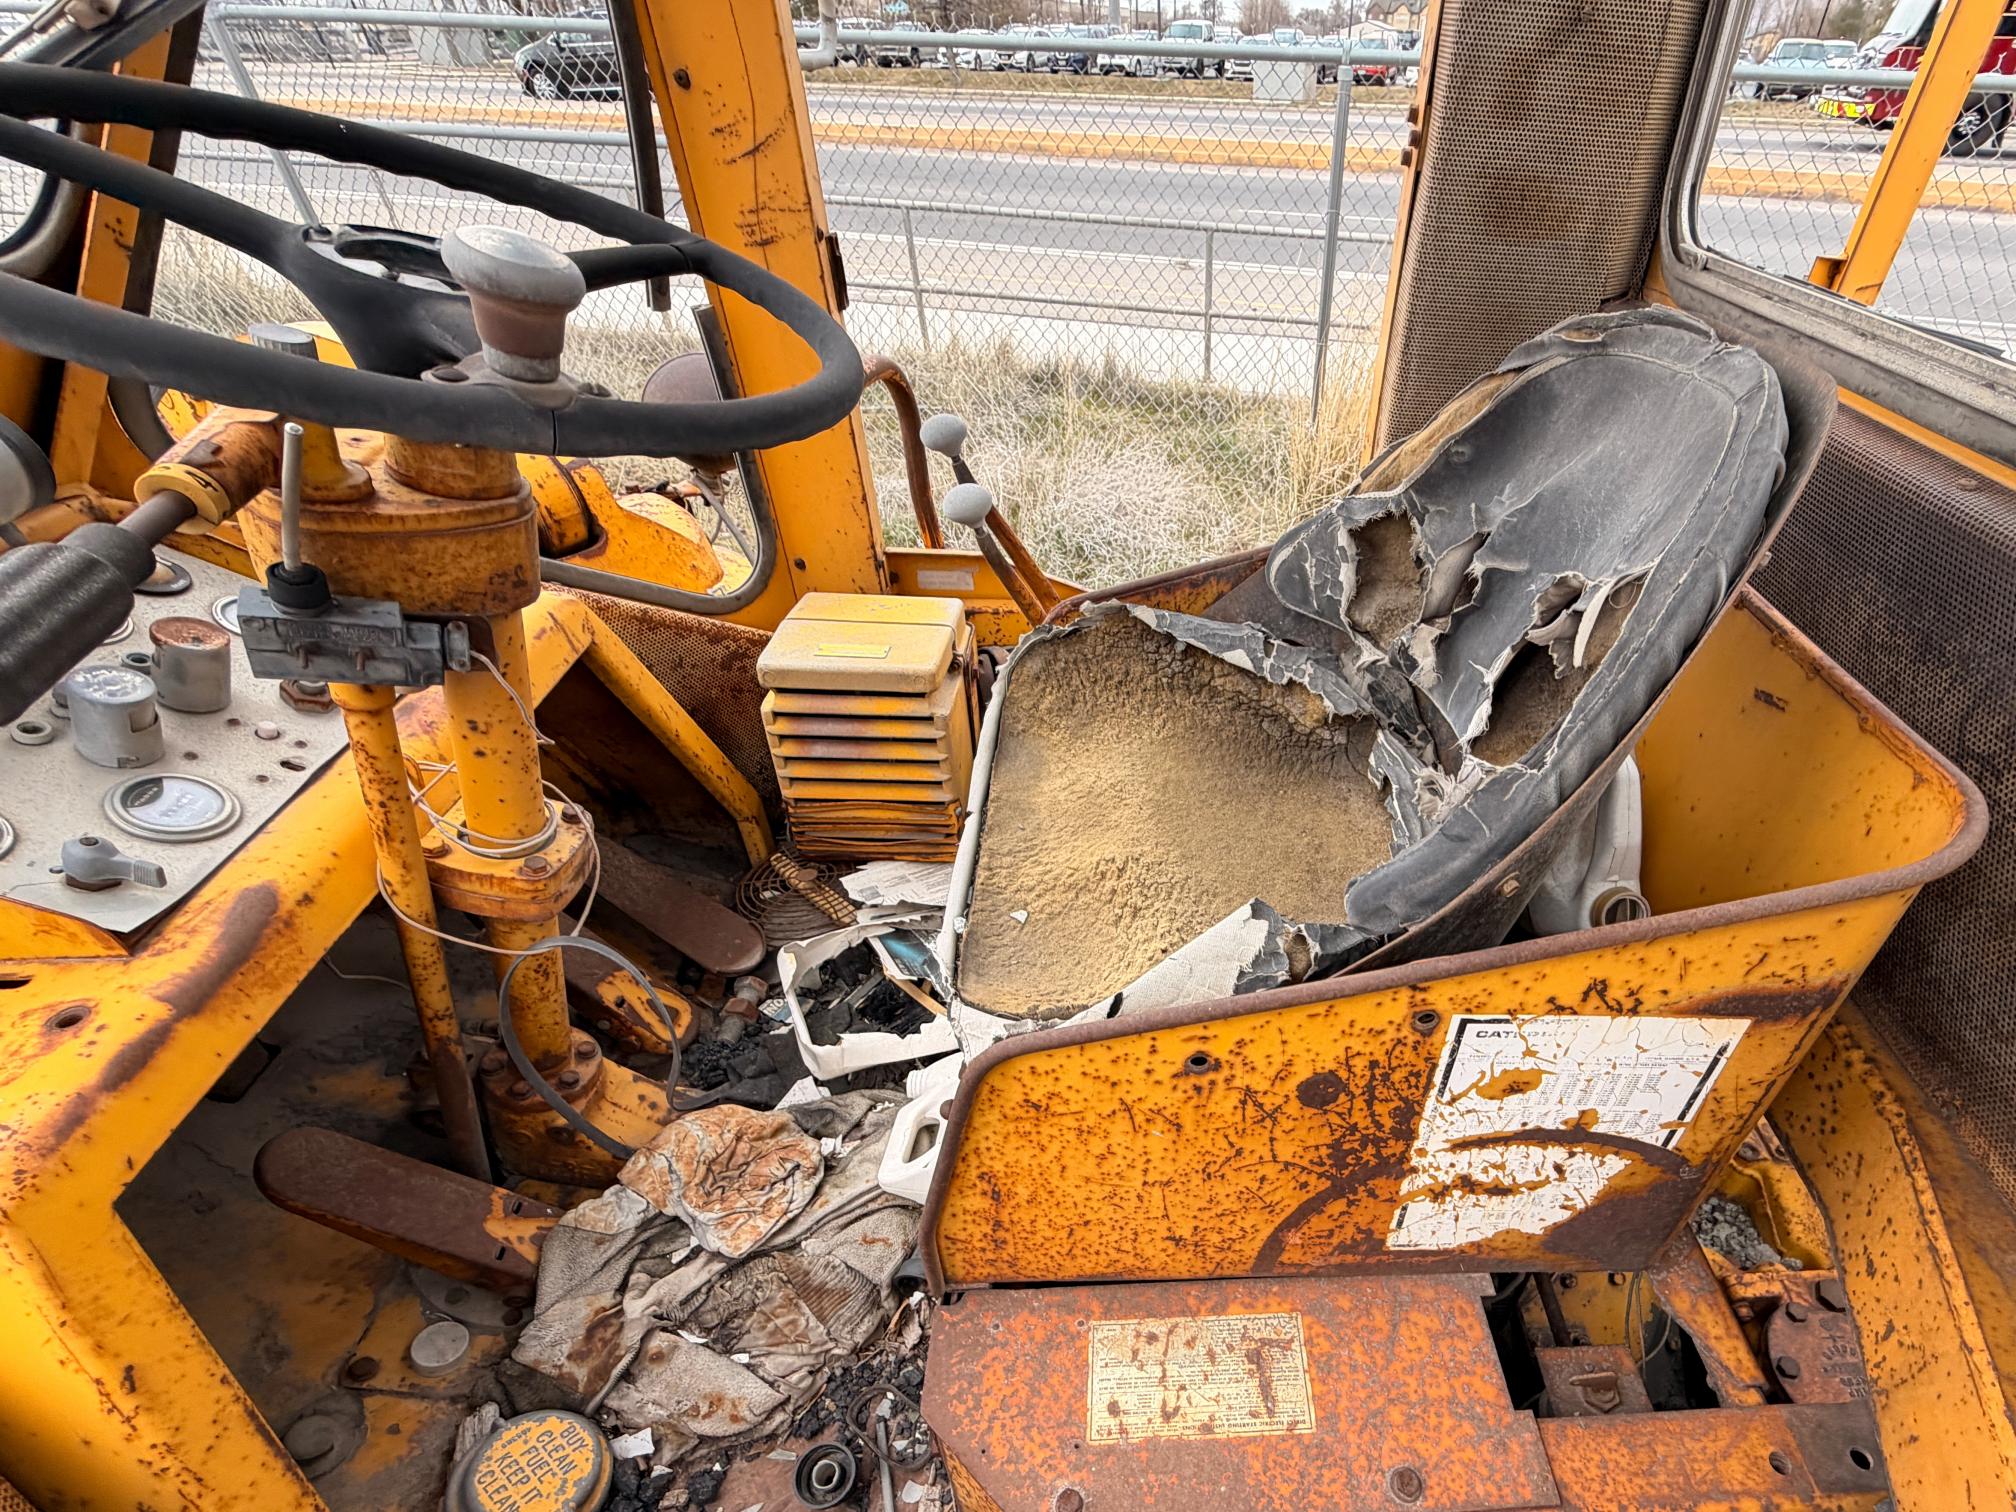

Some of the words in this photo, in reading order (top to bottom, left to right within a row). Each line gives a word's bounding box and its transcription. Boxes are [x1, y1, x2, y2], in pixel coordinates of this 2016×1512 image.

[560, 1424, 589, 1453] BUY
[1182, 1423, 1226, 1431] INSTIONS
[519, 1446, 554, 1484] FUEL
[536, 1430, 578, 1476] CLEAN
[477, 1469, 521, 1512] CLEAN
[494, 1452, 531, 1487] KEEP
[520, 1486, 544, 1505] IT
